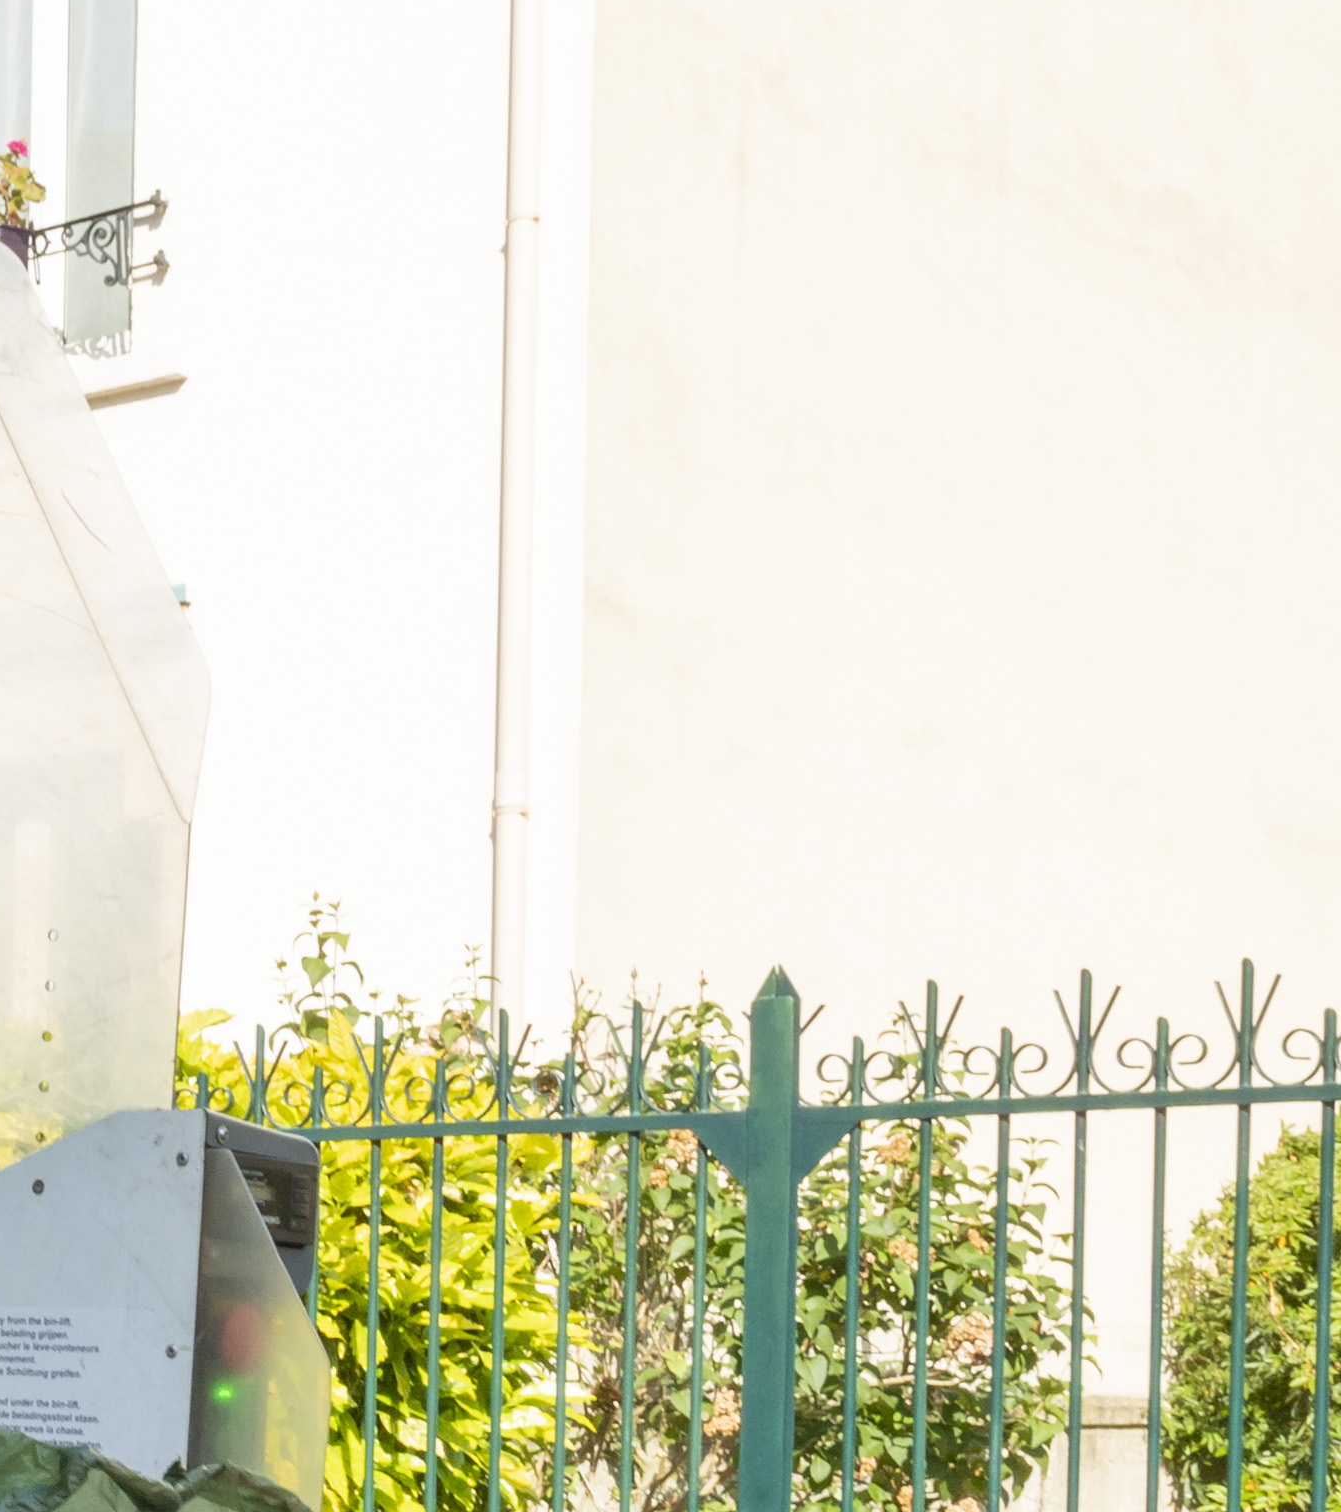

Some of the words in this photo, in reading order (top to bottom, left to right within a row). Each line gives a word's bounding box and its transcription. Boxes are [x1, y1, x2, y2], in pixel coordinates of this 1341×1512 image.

[7, 1316, 27, 1325] from
[28, 1317, 41, 1325] the
[1, 1329, 36, 1340] belading
[23, 1343, 31, 1351] le
[10, 1399, 34, 1408] under
[36, 1399, 49, 1408] the
[0, 1411, 10, 1419] de
[24, 1426, 44, 1435] sous
[46, 1426, 55, 1435] la
